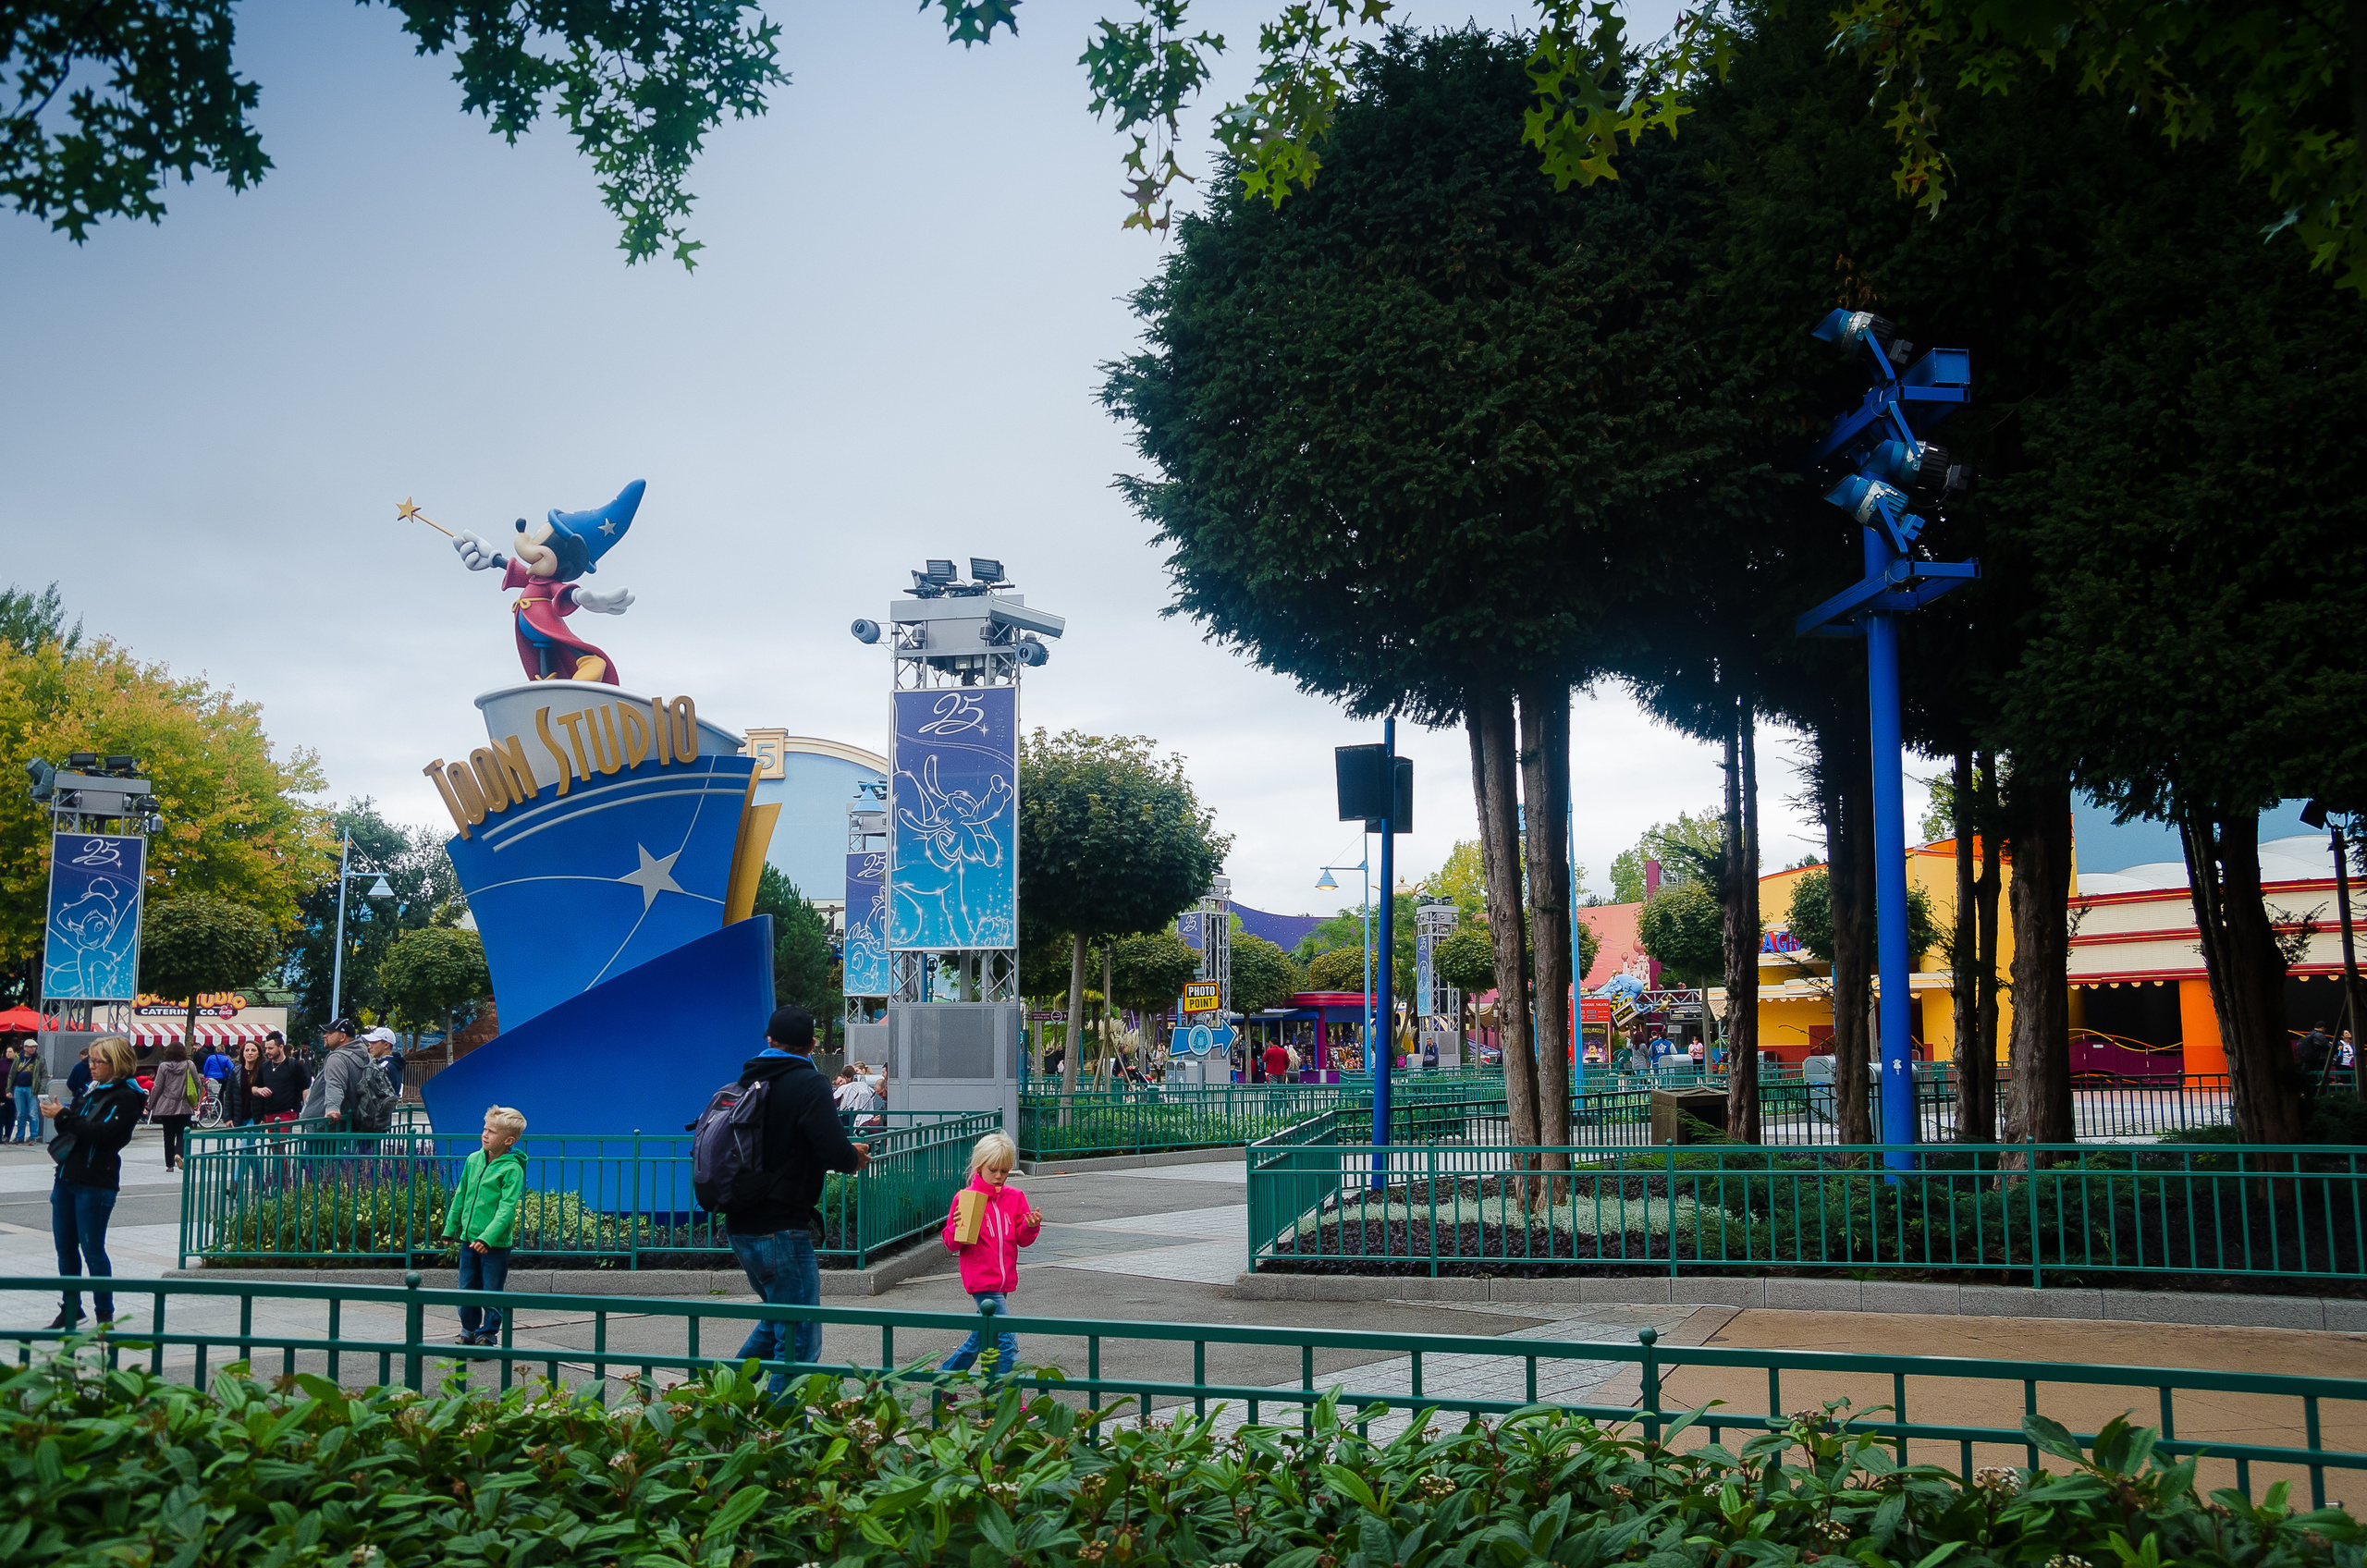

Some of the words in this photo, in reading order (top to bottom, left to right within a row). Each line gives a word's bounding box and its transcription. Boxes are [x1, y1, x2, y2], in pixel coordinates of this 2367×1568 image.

[917, 692, 985, 735] 25
[423, 734, 539, 840] TOON
[535, 695, 699, 796] STUDIO
[756, 743, 775, 769] 5
[72, 839, 120, 865] 25
[857, 853, 886, 877] 25
[1183, 915, 1197, 932] 25
[1188, 986, 1216, 997] PHOTO
[1189, 998, 1213, 1009] POINT
